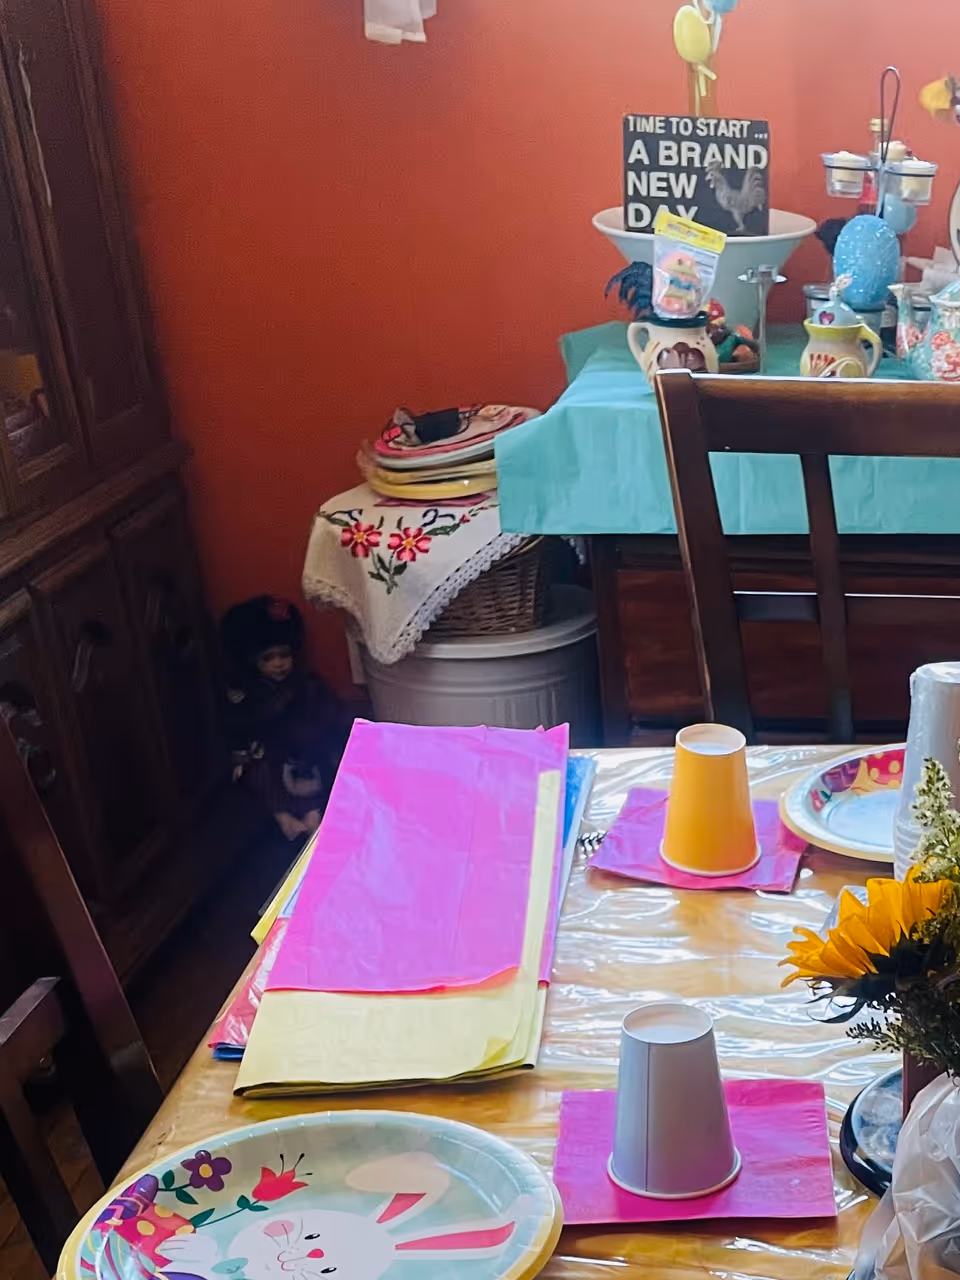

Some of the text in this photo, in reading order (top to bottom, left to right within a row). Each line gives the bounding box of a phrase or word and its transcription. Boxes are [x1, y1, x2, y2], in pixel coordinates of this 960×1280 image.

[627, 115, 665, 134] TIME
[669, 117, 693, 136] TO
[696, 118, 751, 138] START
[628, 139, 768, 169] A BRAND
[627, 171, 698, 199] NEW
